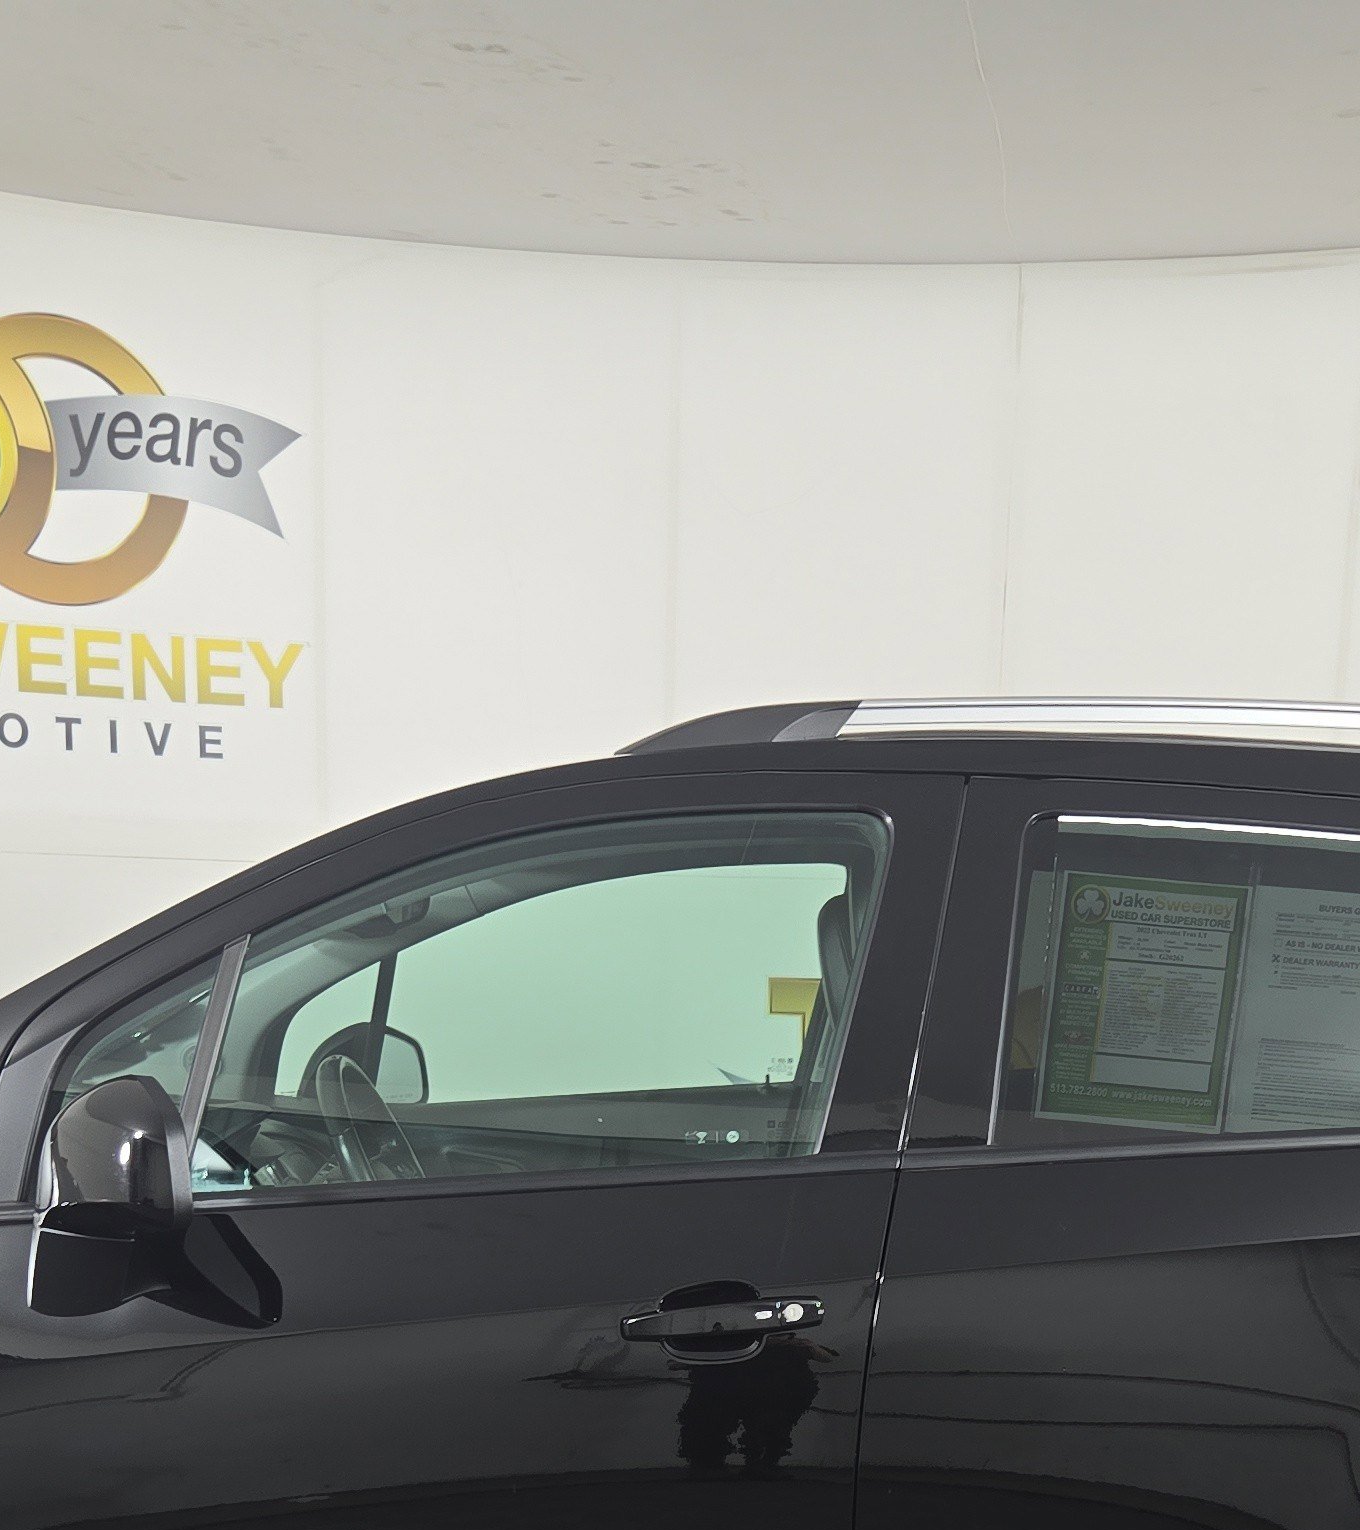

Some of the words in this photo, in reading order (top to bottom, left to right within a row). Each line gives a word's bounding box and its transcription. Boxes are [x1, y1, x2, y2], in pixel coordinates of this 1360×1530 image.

[69, 409, 244, 478] years
[1319, 904, 1353, 915] BUYERS
[1111, 910, 1138, 921] USED
[1140, 913, 1162, 923] CAR
[1164, 914, 1232, 929] SUPERSTORE
[1312, 942, 1324, 950] NO
[1325, 943, 1356, 953] DEALER
[1282, 957, 1315, 966] DEALER
[1316, 958, 1360, 970] WARRANTY
